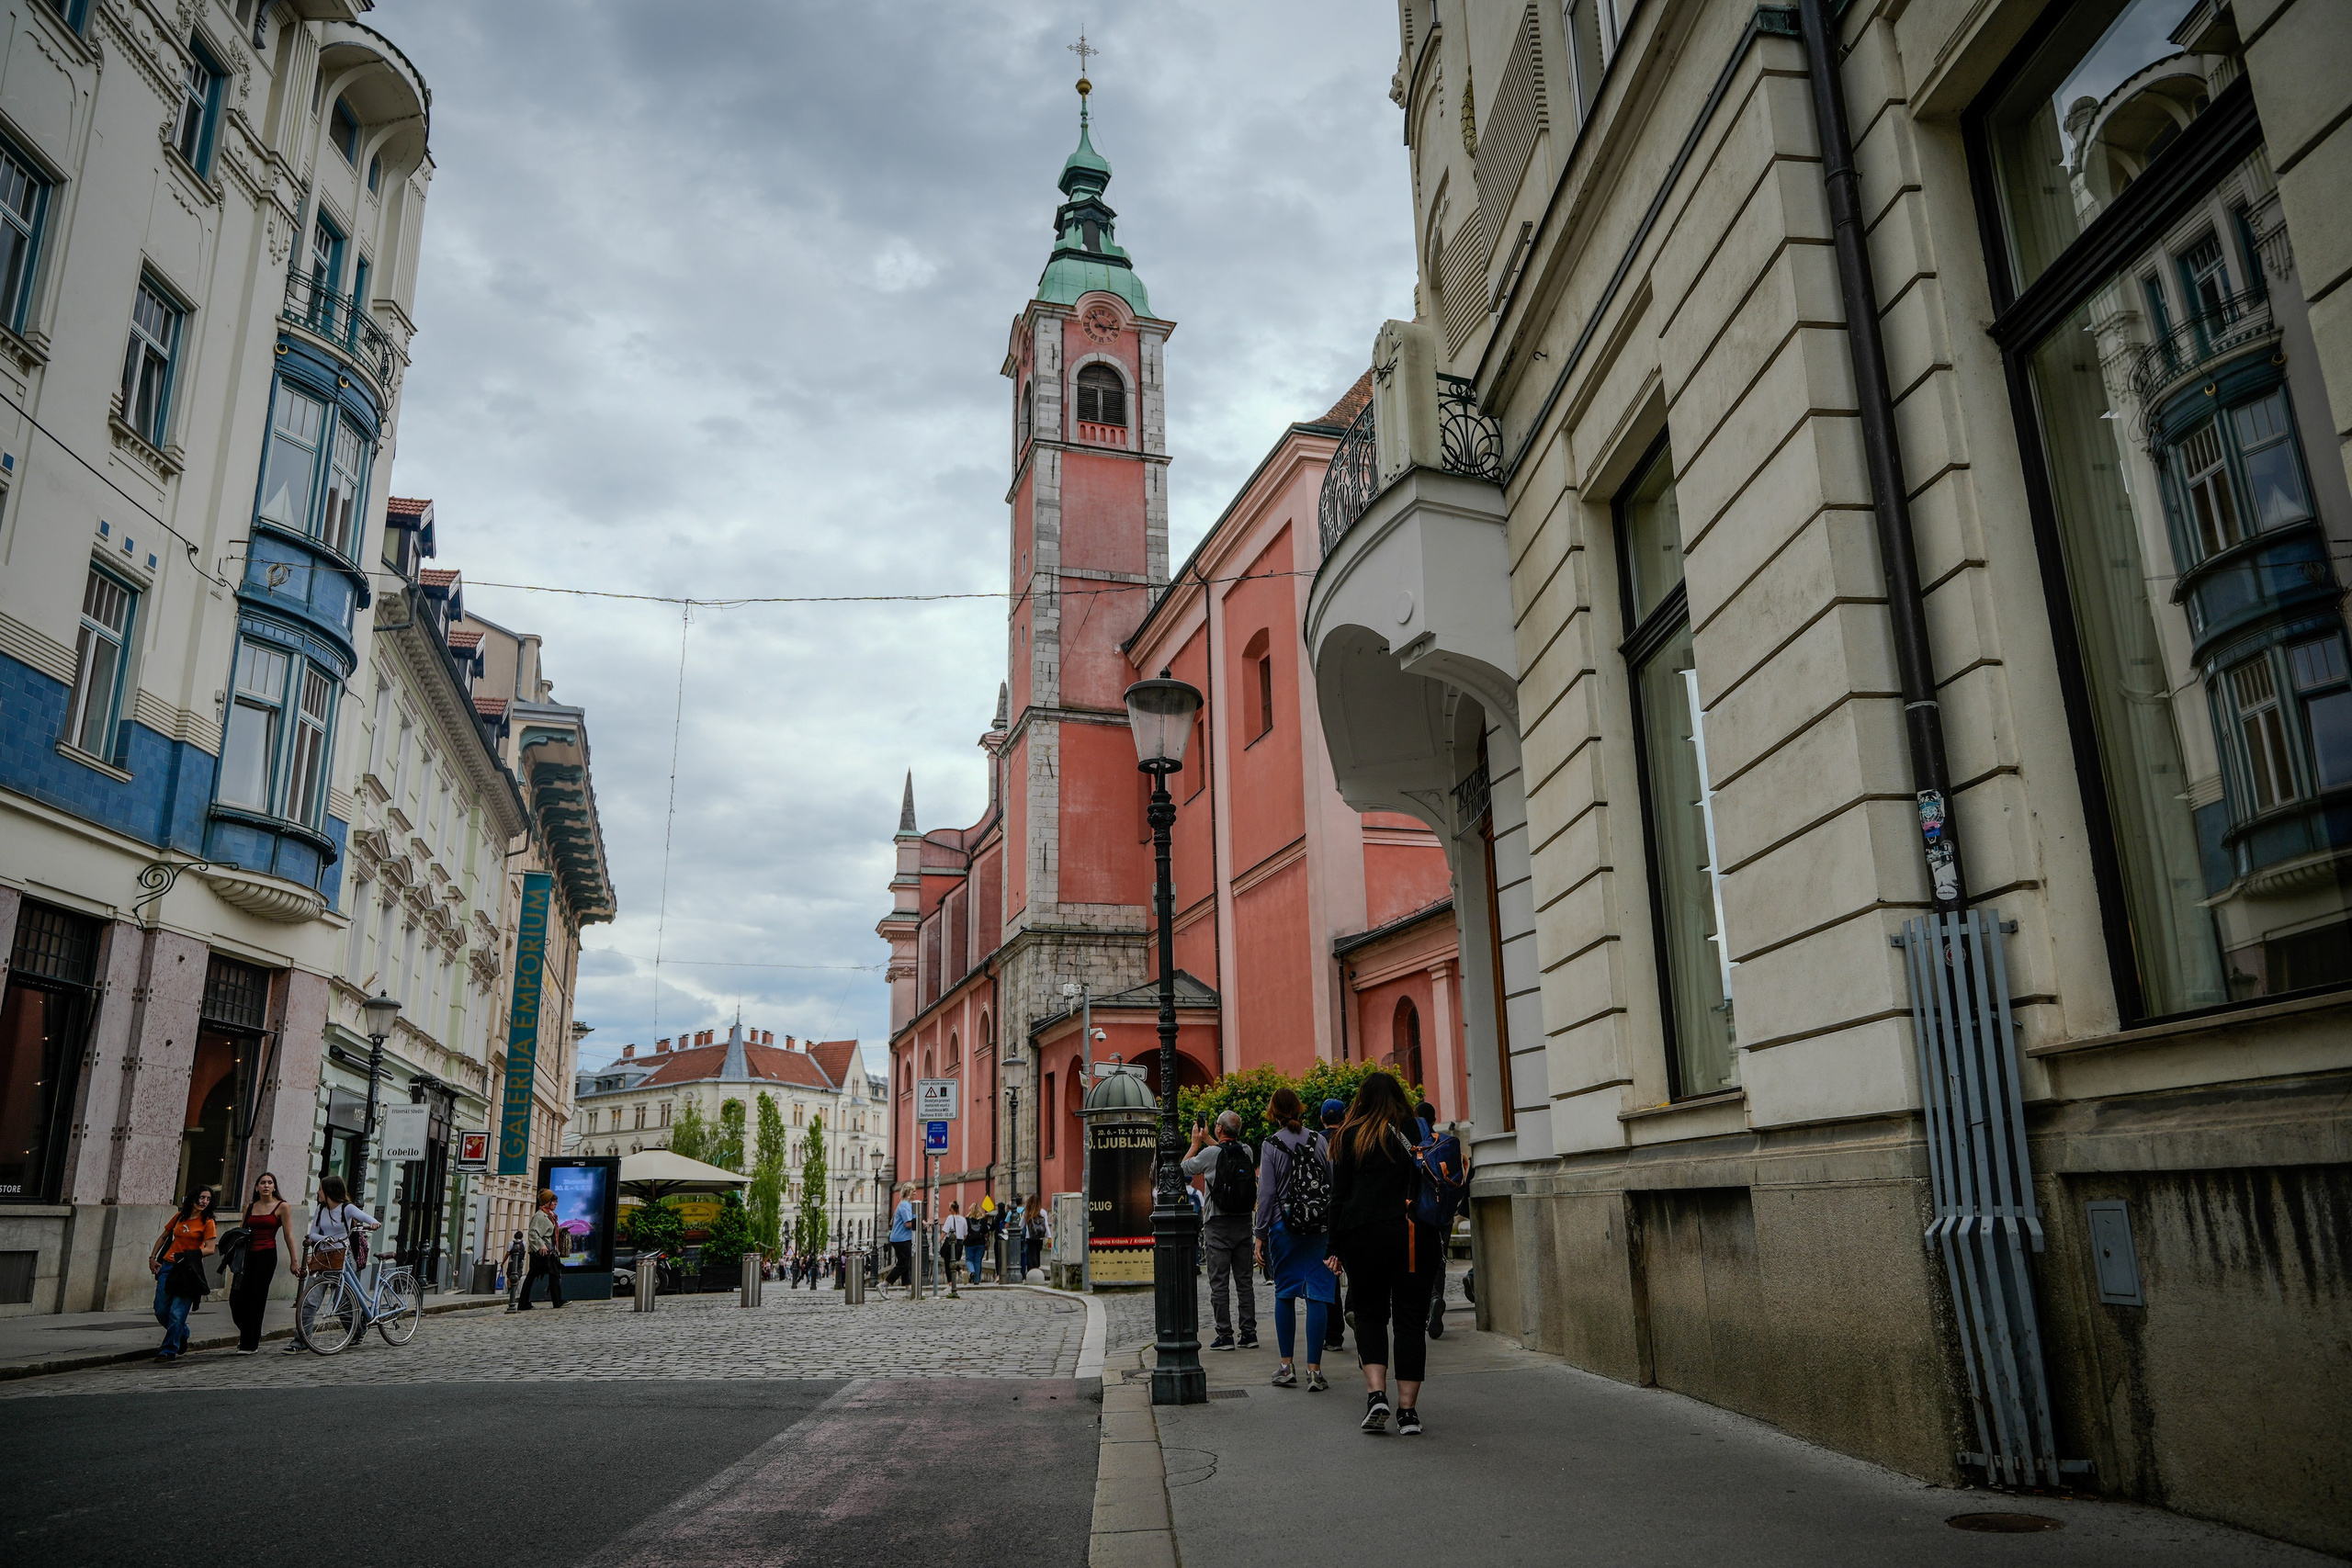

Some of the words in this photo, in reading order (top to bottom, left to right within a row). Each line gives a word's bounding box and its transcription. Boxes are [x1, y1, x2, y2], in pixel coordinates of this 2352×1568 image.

[513, 887, 548, 1029] EMPORIUM
[503, 1037, 534, 1158] GALERIJA
[1097, 1136, 1157, 1150] LJUBLJANA
[387, 1147, 419, 1156] Cobello
[0, 1184, 22, 1193] STORE
